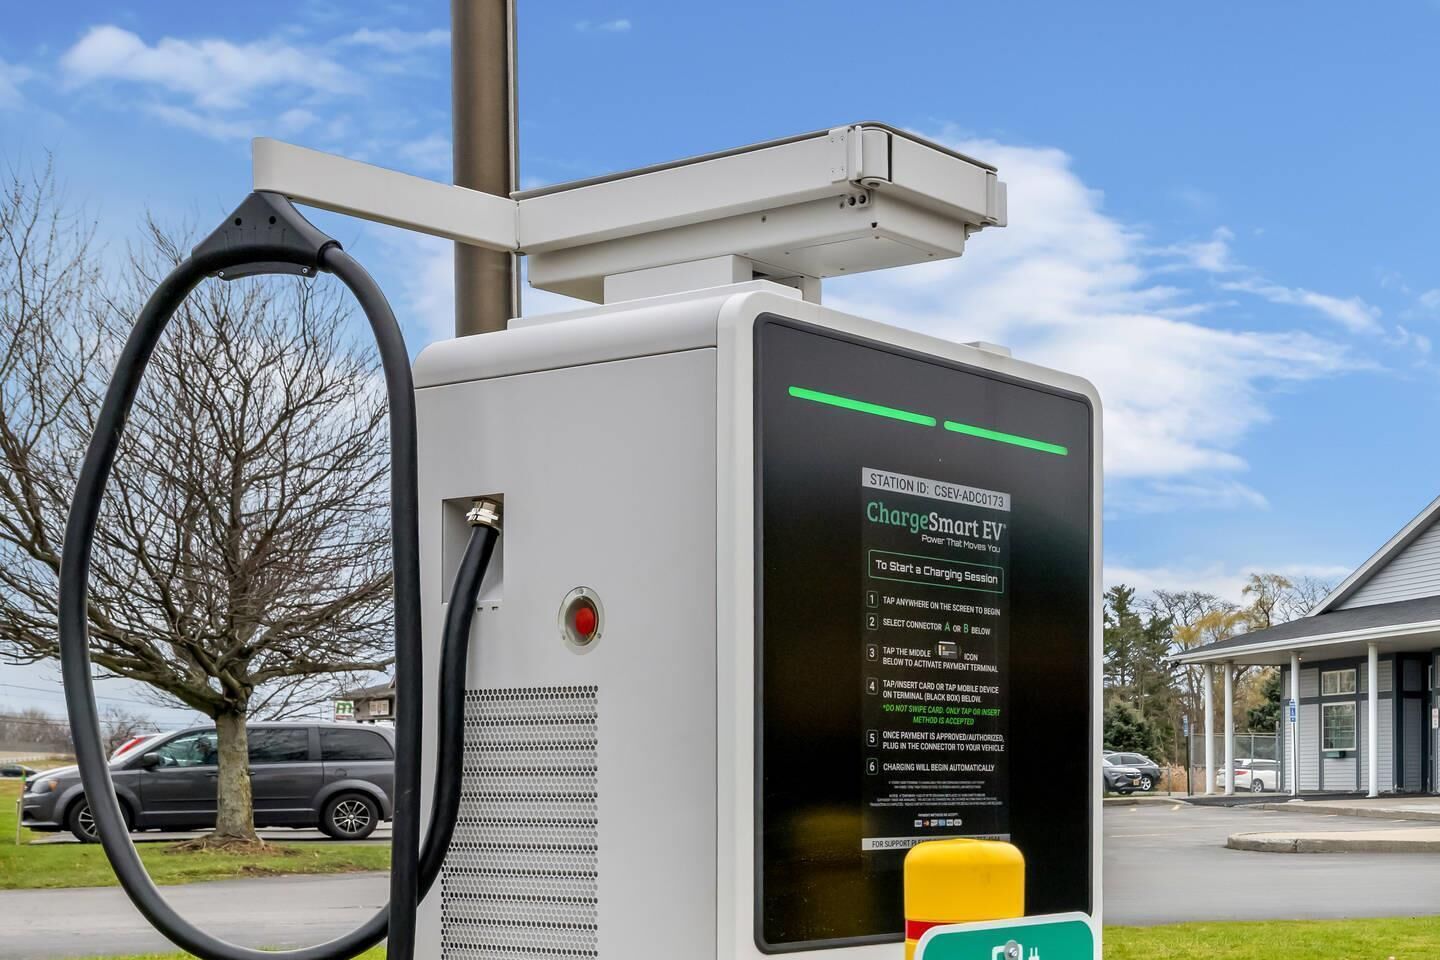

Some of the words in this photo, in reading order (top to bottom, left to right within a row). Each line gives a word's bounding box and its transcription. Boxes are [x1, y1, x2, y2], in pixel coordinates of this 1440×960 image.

[870, 473, 914, 493] STATION
[917, 482, 929, 495] ID:
[934, 485, 1004, 507] CSEV-ADC0173
[867, 502, 980, 538] ChargeSmart
[982, 520, 1003, 541] EV
[921, 534, 945, 545] Power
[946, 537, 962, 548] That
[963, 540, 987, 551] Moves
[987, 544, 1001, 553] You
[875, 559, 887, 570] To
[889, 561, 914, 574] Start
[915, 566, 922, 575] a
[923, 566, 963, 582] Charging
[964, 571, 998, 585] Session
[869, 594, 874, 604] 1
[882, 596, 895, 605] TAP
[896, 598, 930, 609] ANYWHERE
[930, 601, 939, 610] ON
[940, 602, 952, 611] THE
[952, 604, 974, 614] SCREEN
[975, 606, 983, 614] TO
[983, 607, 1000, 616] BEGIN
[869, 616, 875, 627] 2
[882, 618, 905, 628] SELECT
[906, 620, 942, 631] CONNECTOR
[944, 621, 950, 632] A
[952, 624, 961, 633] OR
[963, 623, 969, 633] B
[971, 626, 991, 636] BELOW
[869, 648, 875, 658] 3
[882, 646, 895, 655] TAP
[896, 647, 908, 656] THE
[909, 648, 931, 658] MIDDLE
[963, 652, 979, 661] ICON
[882, 656, 904, 666] BELOW
[904, 658, 913, 667] TO
[914, 659, 942, 669] ACTIVATE
[942, 661, 970, 671] PAYMENT
[970, 663, 998, 673] TERMINAL
[869, 681, 875, 691] 4
[882, 679, 918, 689] TAP/INSERT
[918, 681, 935, 690] CARD
[935, 682, 945, 691] OR
[945, 683, 956, 691] TAP
[957, 684, 979, 693] MOBILE
[979, 685, 1000, 694] DEVICE
[882, 690, 892, 698] ON
[893, 690, 923, 700] TERMINAL
[924, 692, 946, 702] (BLACK
[946, 693, 960, 703] BOX)
[895, 704, 908, 713] NOT
[912, 716, 938, 724] METHOD
[869, 733, 875, 743] 5
[882, 731, 900, 739] ONCE
[900, 731, 929, 740] PAYMENT
[929, 732, 935, 740] IS
[882, 741, 899, 750] PLUG
[900, 742, 907, 750] IN
[907, 742, 920, 750] THE
[920, 742, 956, 751] CONNECTOR
[956, 743, 964, 751] TO
[965, 743, 980, 751] YOUR
[981, 744, 1005, 752] VEHICLE
[869, 761, 875, 772] 6
[882, 763, 915, 771] CHARGING
[915, 763, 930, 771] WILL
[930, 763, 949, 772] BEGIN
[949, 763, 995, 772] AUTOMATICALLY
[872, 840, 884, 848] FOR
[884, 839, 911, 848] SUPPORT
